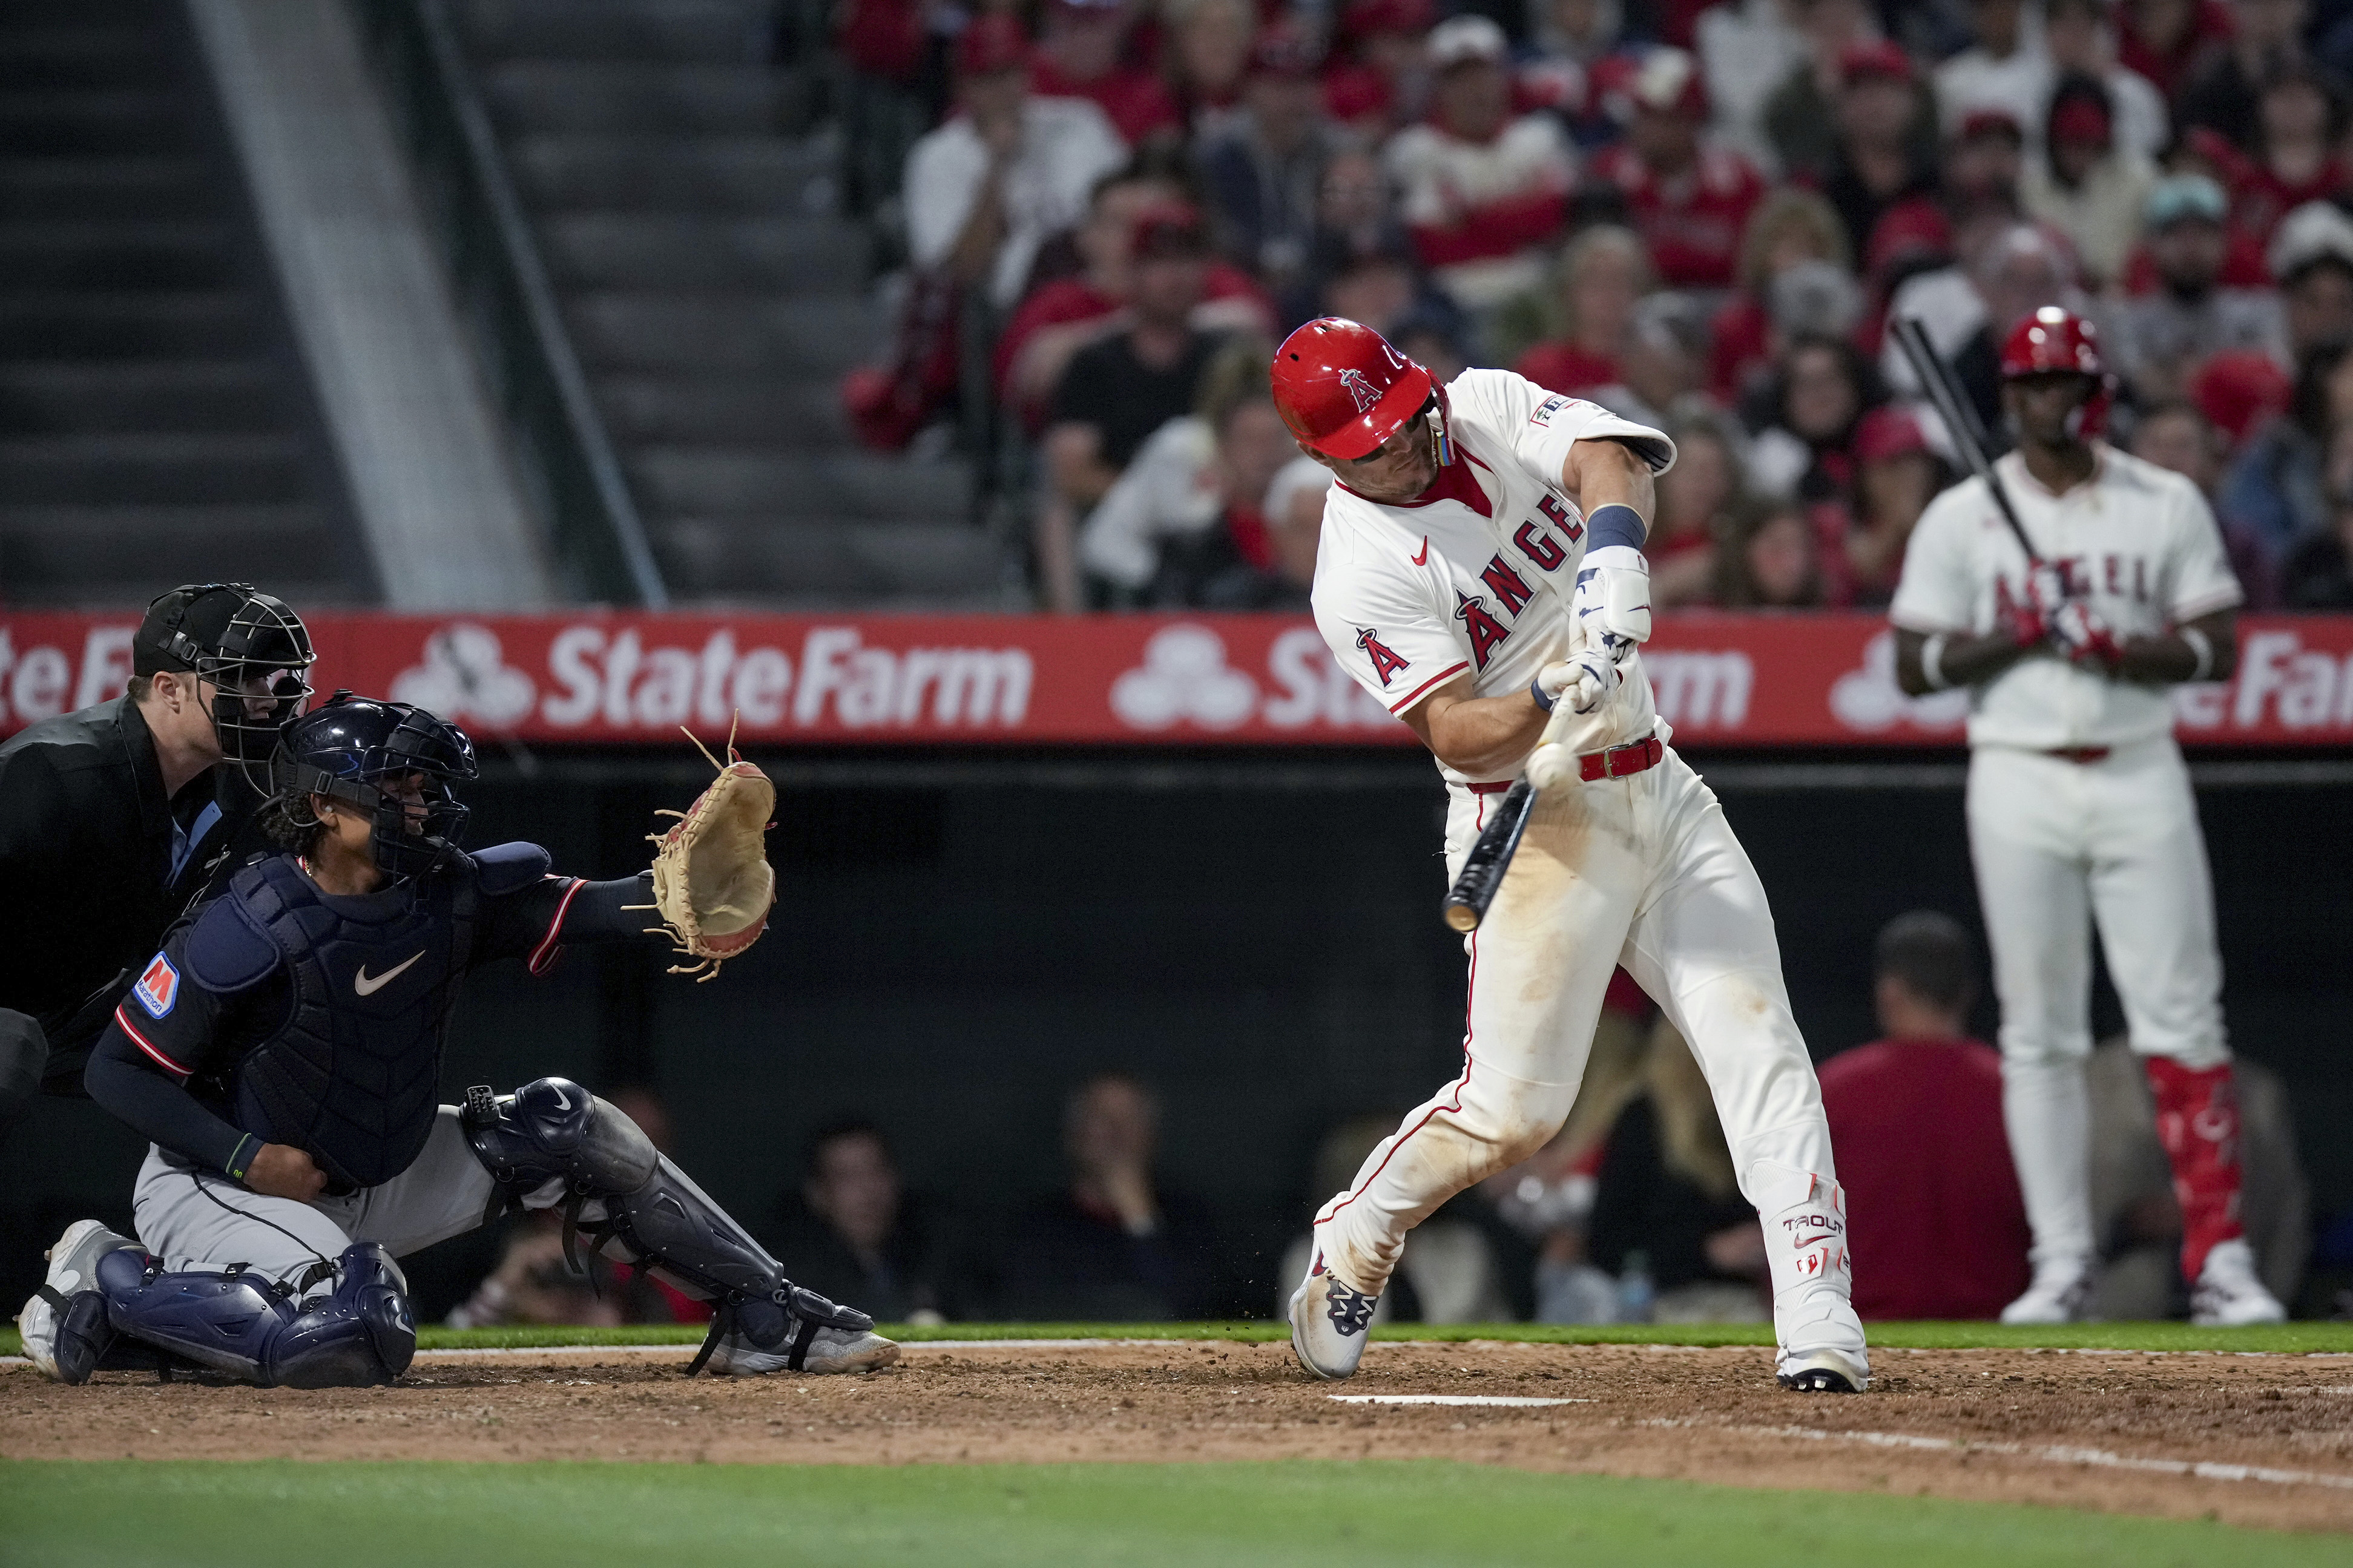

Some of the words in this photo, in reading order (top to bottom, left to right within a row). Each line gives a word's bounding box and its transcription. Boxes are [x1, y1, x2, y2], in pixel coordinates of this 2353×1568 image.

[1340, 369, 1383, 414] A
[1454, 493, 1585, 675] ANGE
[1356, 627, 1411, 687] A
[136, 979, 162, 1012] Marathon
[143, 959, 174, 1004] M
[1783, 1215, 1843, 1235] TROUT
